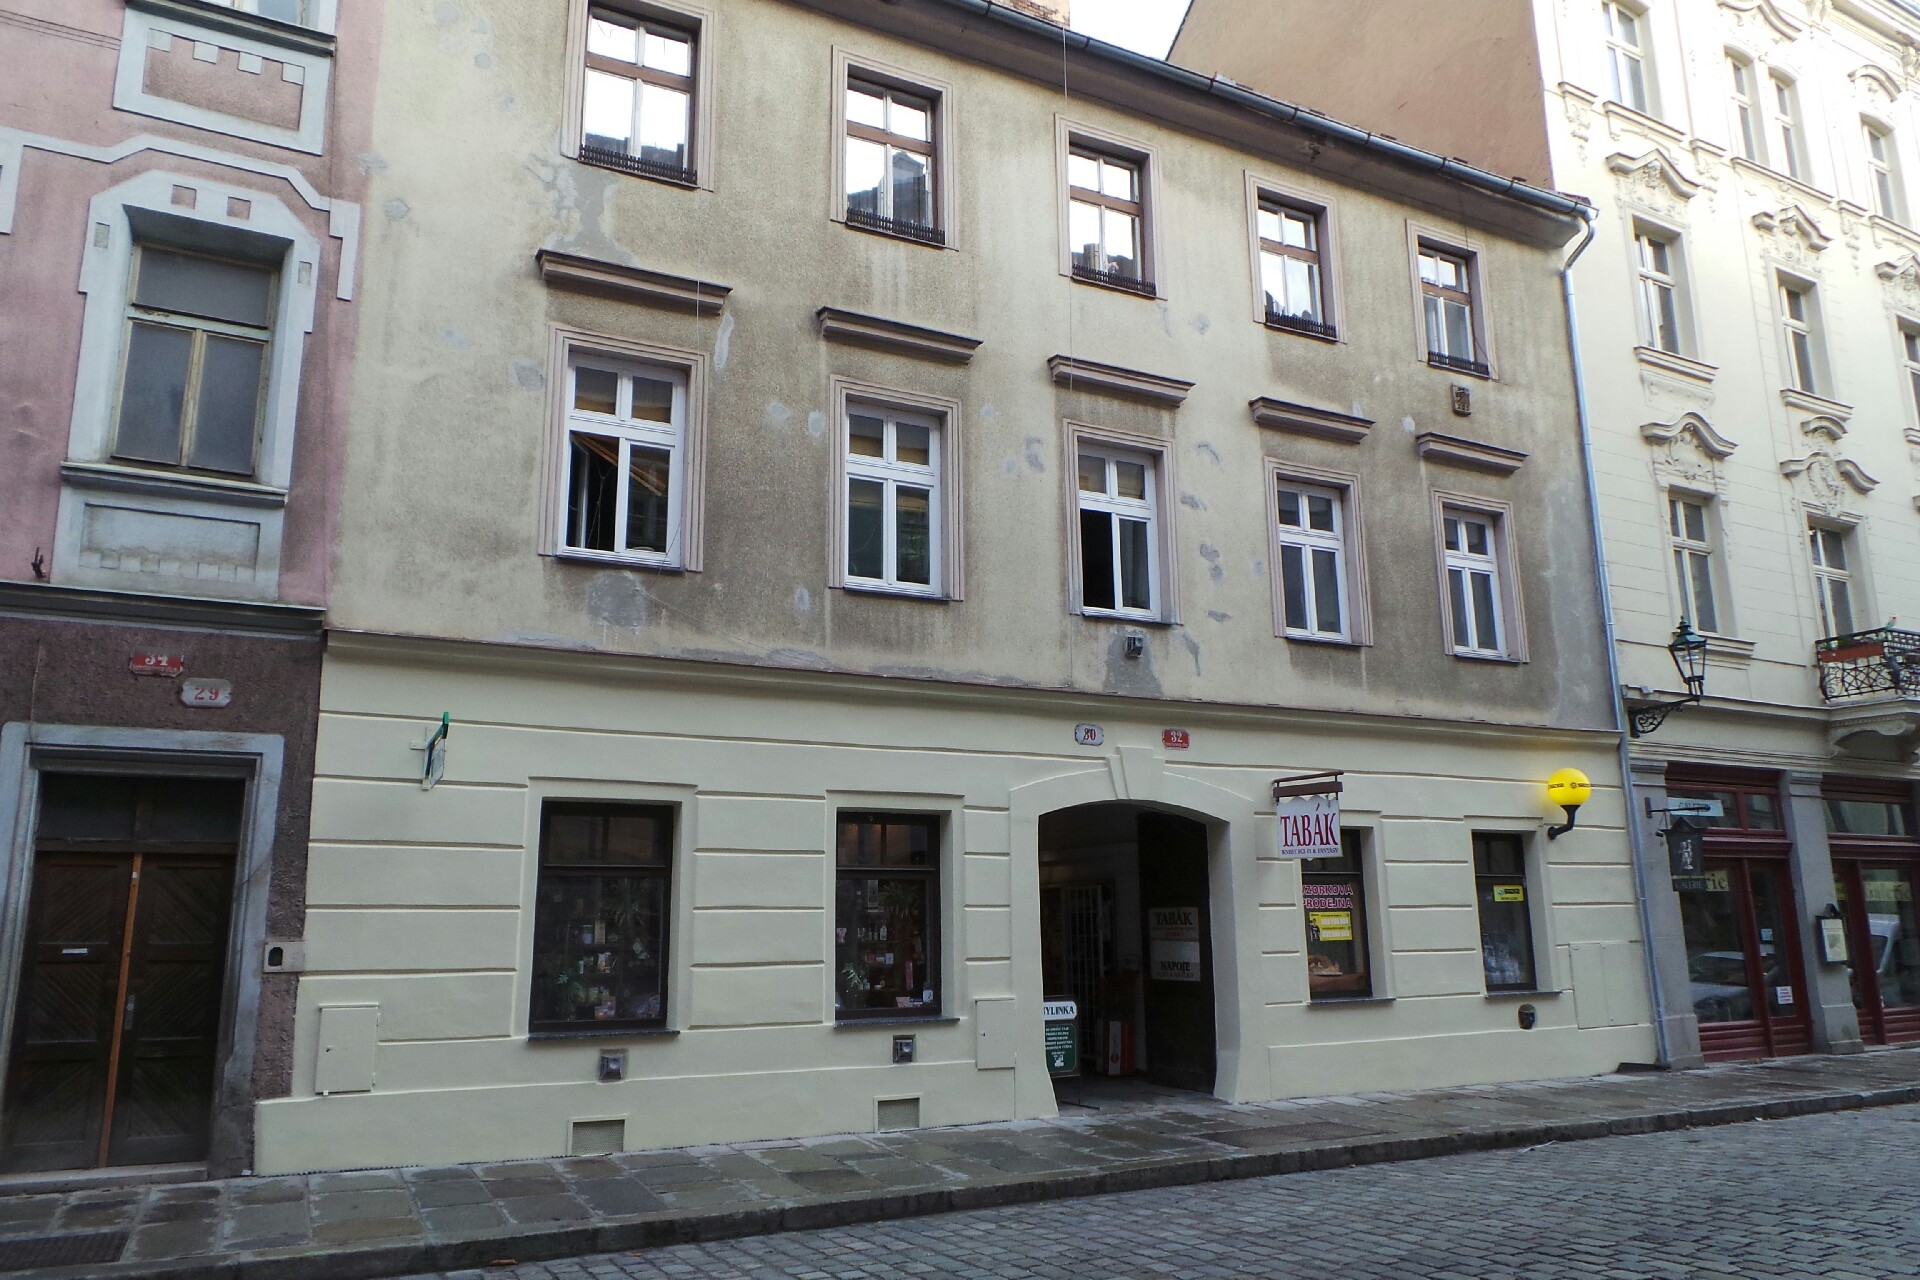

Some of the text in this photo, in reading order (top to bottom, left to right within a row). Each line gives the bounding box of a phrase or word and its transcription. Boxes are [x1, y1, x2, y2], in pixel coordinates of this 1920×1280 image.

[194, 687, 220, 701] 29
[1083, 727, 1097, 741] 30
[1170, 730, 1183, 743] 32
[1280, 802, 1338, 847] TABÁK
[1154, 908, 1193, 926] TABÁK
